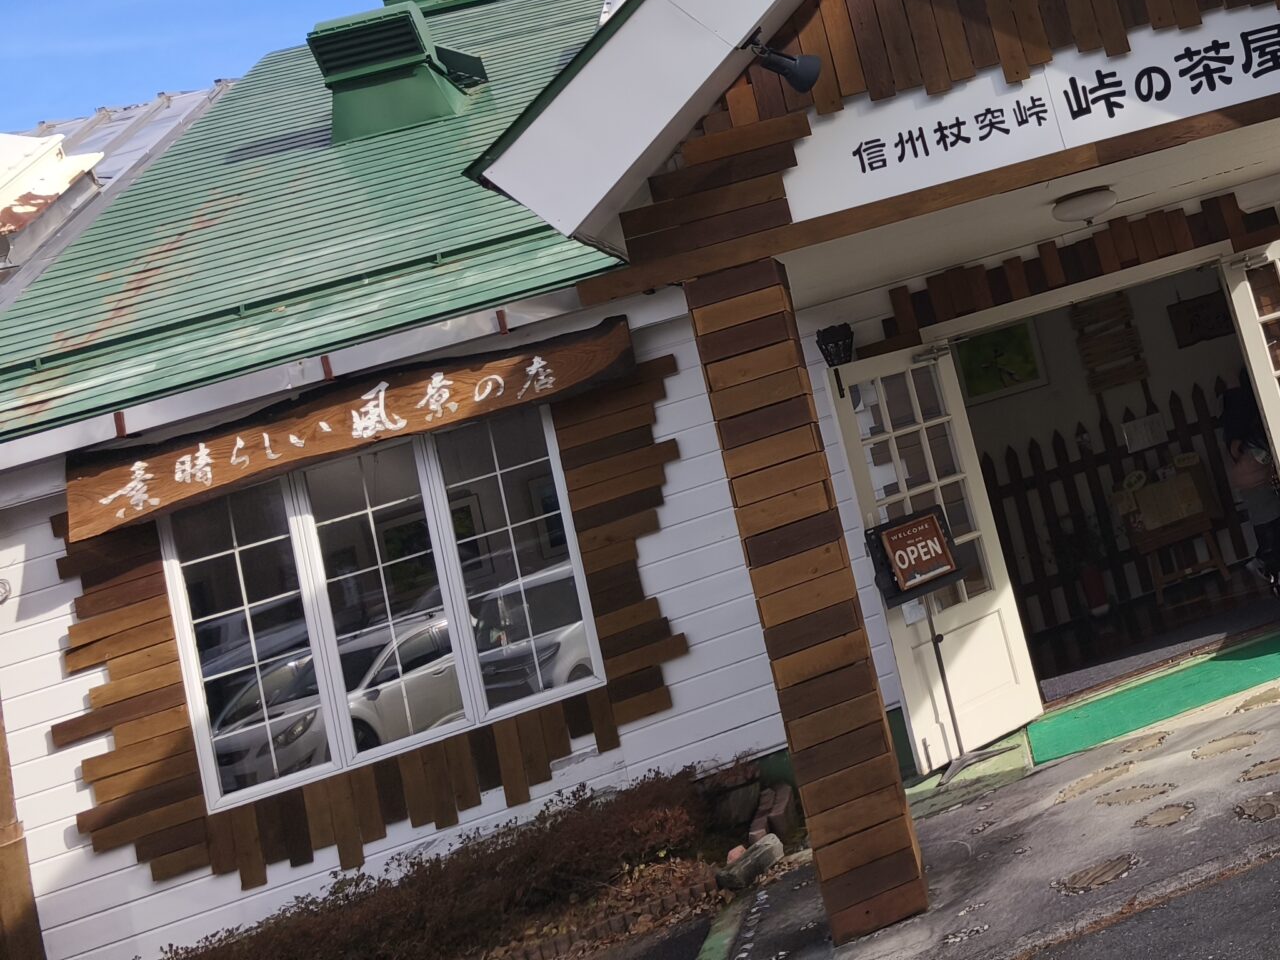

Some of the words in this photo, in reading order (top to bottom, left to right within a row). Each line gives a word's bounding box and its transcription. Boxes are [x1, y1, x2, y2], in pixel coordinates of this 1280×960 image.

[852, 95, 1049, 174] 信州杖突峠
[890, 523, 929, 541] WELCOME
[894, 536, 943, 570] OPEN
